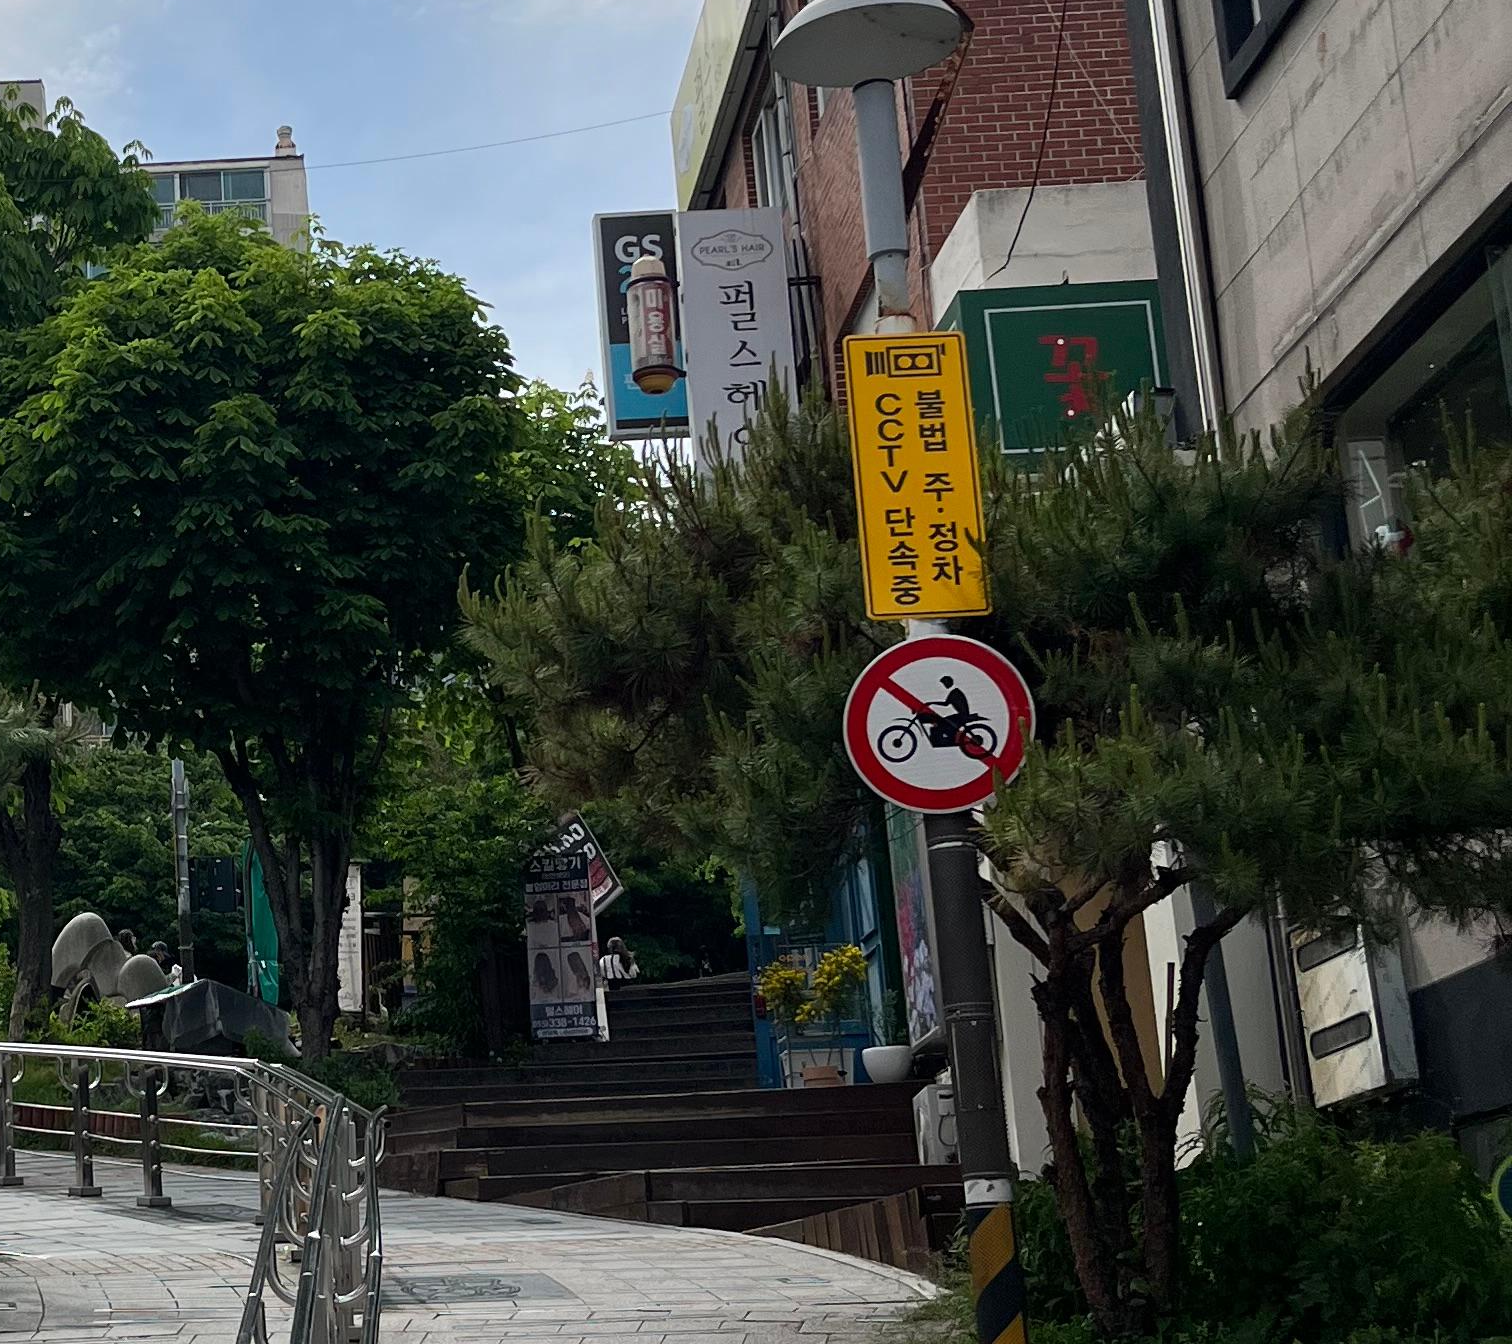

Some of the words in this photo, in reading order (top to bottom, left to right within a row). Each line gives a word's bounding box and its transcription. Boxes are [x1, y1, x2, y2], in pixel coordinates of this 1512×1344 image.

[614, 234, 664, 264] GS
[698, 244, 738, 256] PEARL'S
[740, 243, 766, 255] HAIR
[644, 287, 669, 356] 미용실
[874, 392, 908, 494] CCTV
[914, 389, 948, 453] 불법
[885, 506, 922, 606] 단속중
[923, 472, 964, 586] 주·정차
